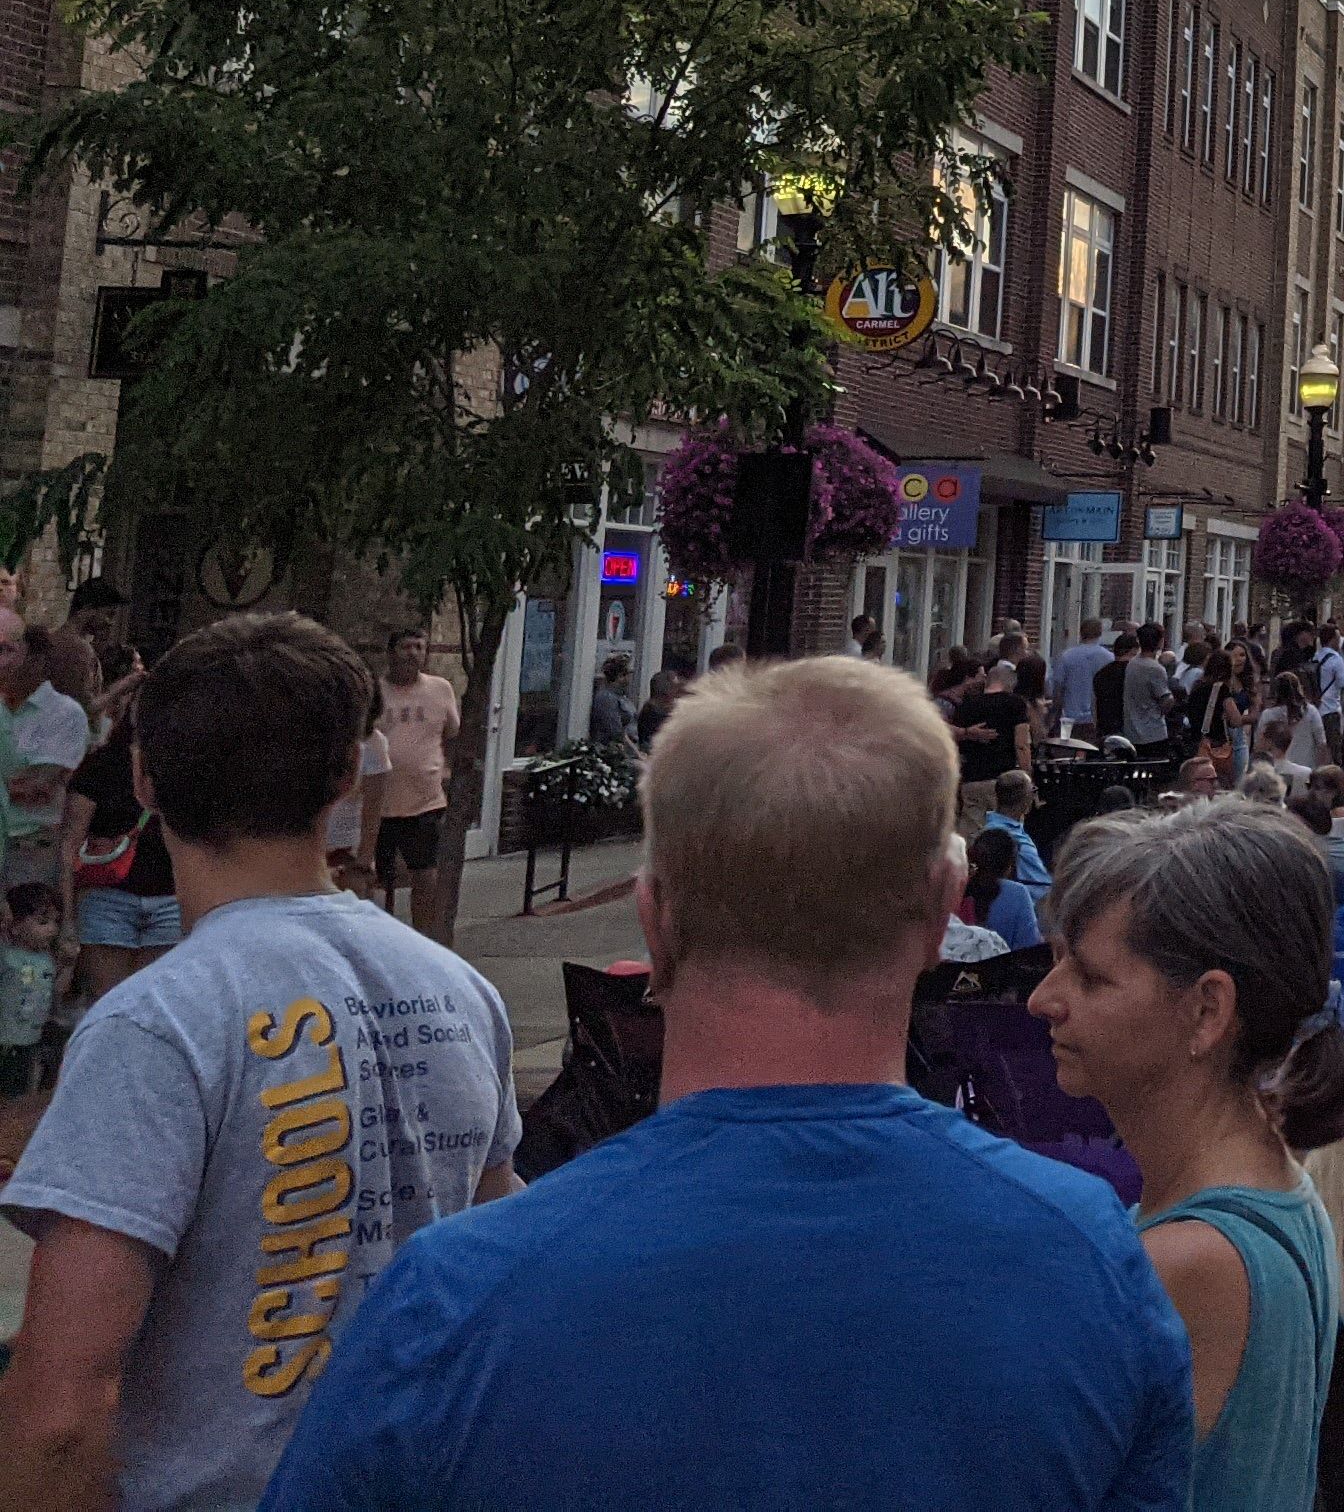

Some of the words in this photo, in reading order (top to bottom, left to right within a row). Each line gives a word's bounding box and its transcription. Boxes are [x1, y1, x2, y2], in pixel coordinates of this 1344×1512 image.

[842, 271, 914, 318] Art
[856, 320, 900, 329] CARMEL
[898, 503, 950, 524] allery
[908, 524, 949, 545] gifts
[605, 556, 634, 577] OPEN
[418, 1023, 472, 1045] Social
[243, 996, 355, 1399] SCHOOLS
